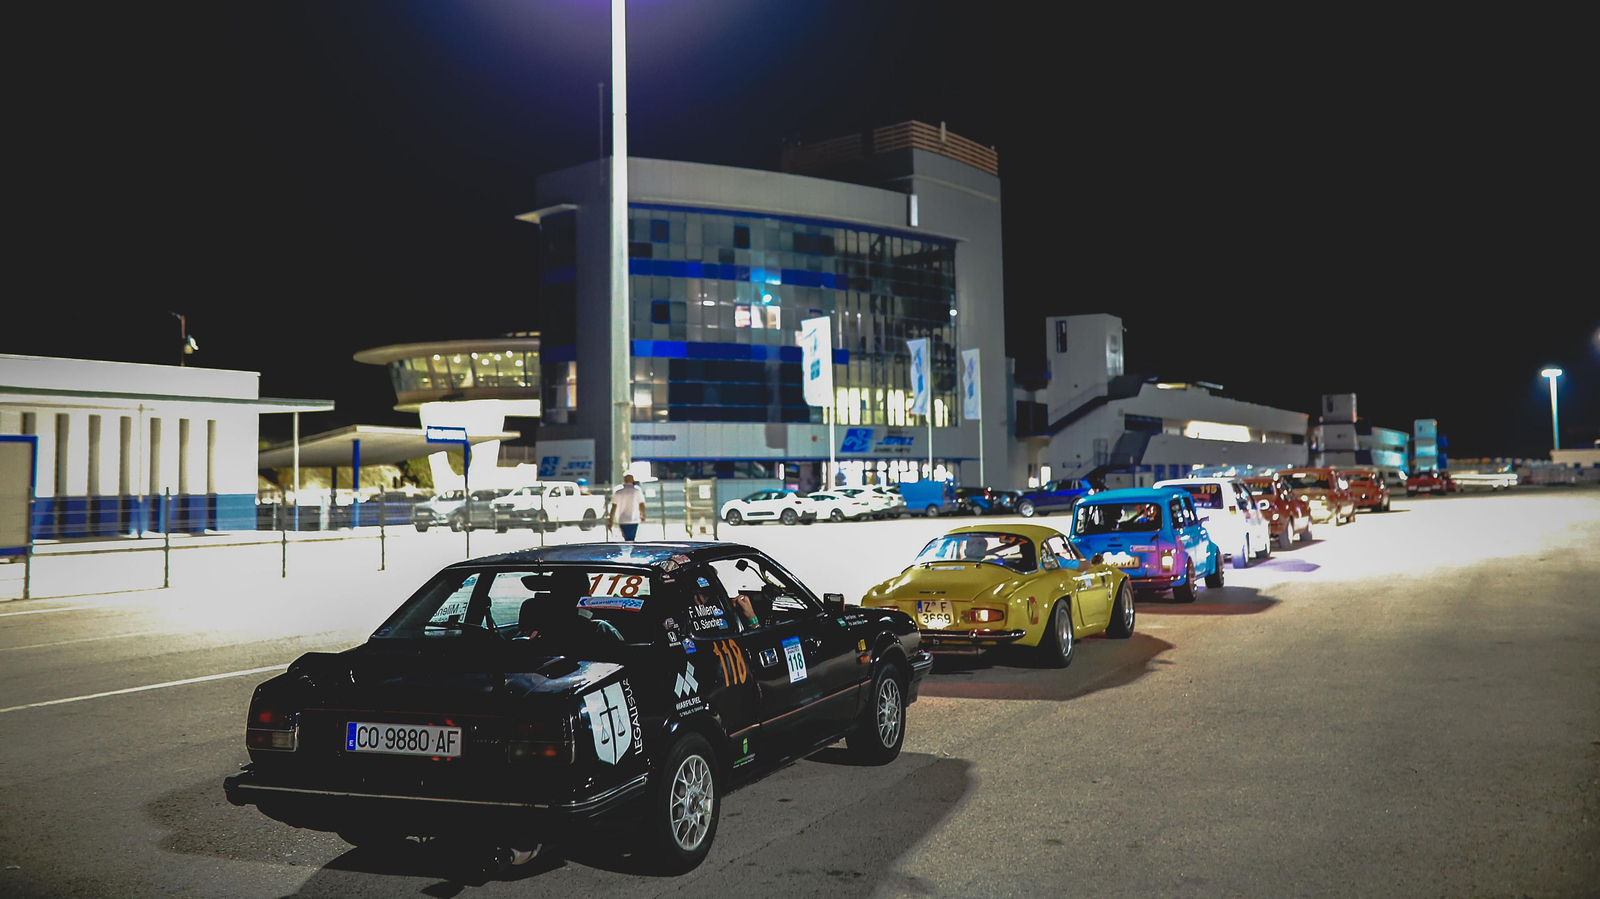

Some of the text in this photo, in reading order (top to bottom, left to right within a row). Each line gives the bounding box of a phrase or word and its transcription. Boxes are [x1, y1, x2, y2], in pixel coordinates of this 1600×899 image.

[588, 573, 643, 597] 118
[688, 606, 696, 619] F.
[693, 621, 702, 631] D.
[713, 638, 747, 687] 118
[789, 652, 804, 672] 118
[435, 730, 459, 753] AF
